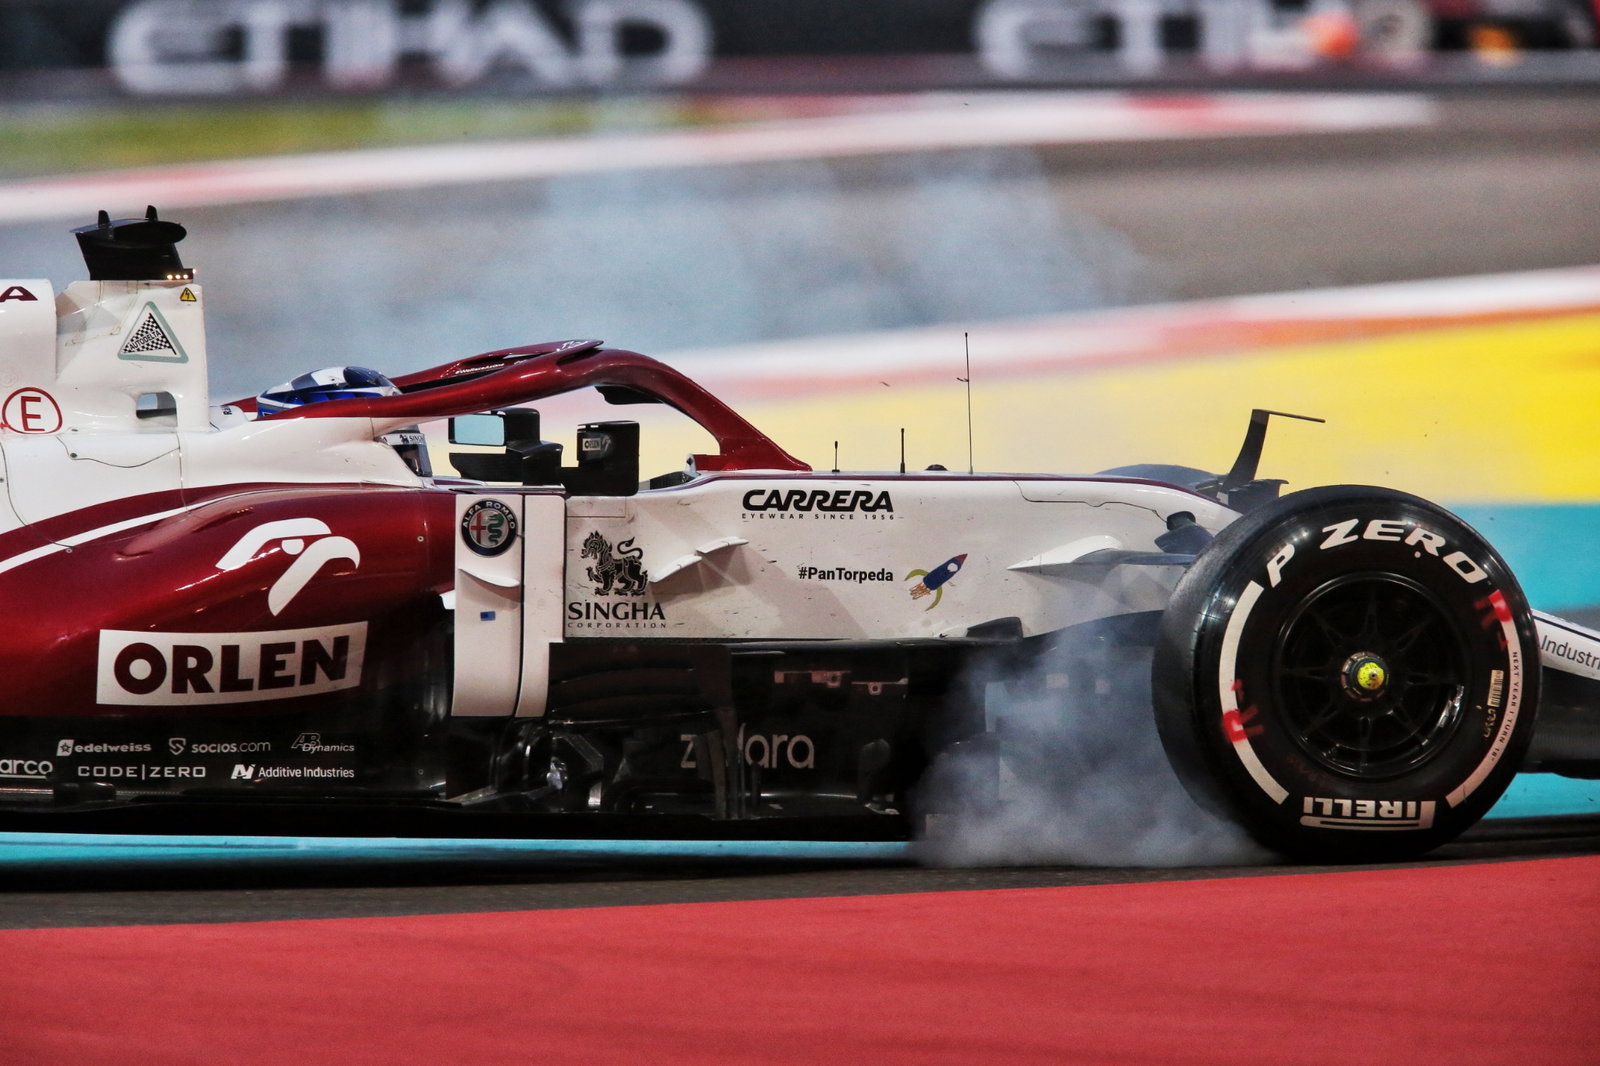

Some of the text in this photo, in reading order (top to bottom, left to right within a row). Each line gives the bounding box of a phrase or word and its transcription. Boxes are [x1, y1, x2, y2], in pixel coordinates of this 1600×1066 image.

[21, 396, 45, 431] E
[742, 489, 894, 513] CARRERA
[462, 501, 516, 529] ALFA ROMEO
[1266, 518, 1488, 588] P ZERO
[798, 567, 894, 584] #PanTorpeda
[568, 602, 666, 621] SINGHA
[113, 635, 350, 695] ORLEN
[1512, 651, 1520, 676] NEXT
[1511, 682, 1519, 707] YEAR
[1500, 718, 1513, 743] TURN
[74, 743, 152, 753] edelweiss
[191, 741, 271, 753] socios.com
[302, 742, 355, 754] Dynamics
[258, 766, 302, 778] Additive
[303, 766, 355, 778] Industries
[1300, 796, 1436, 831] PIRELLI
